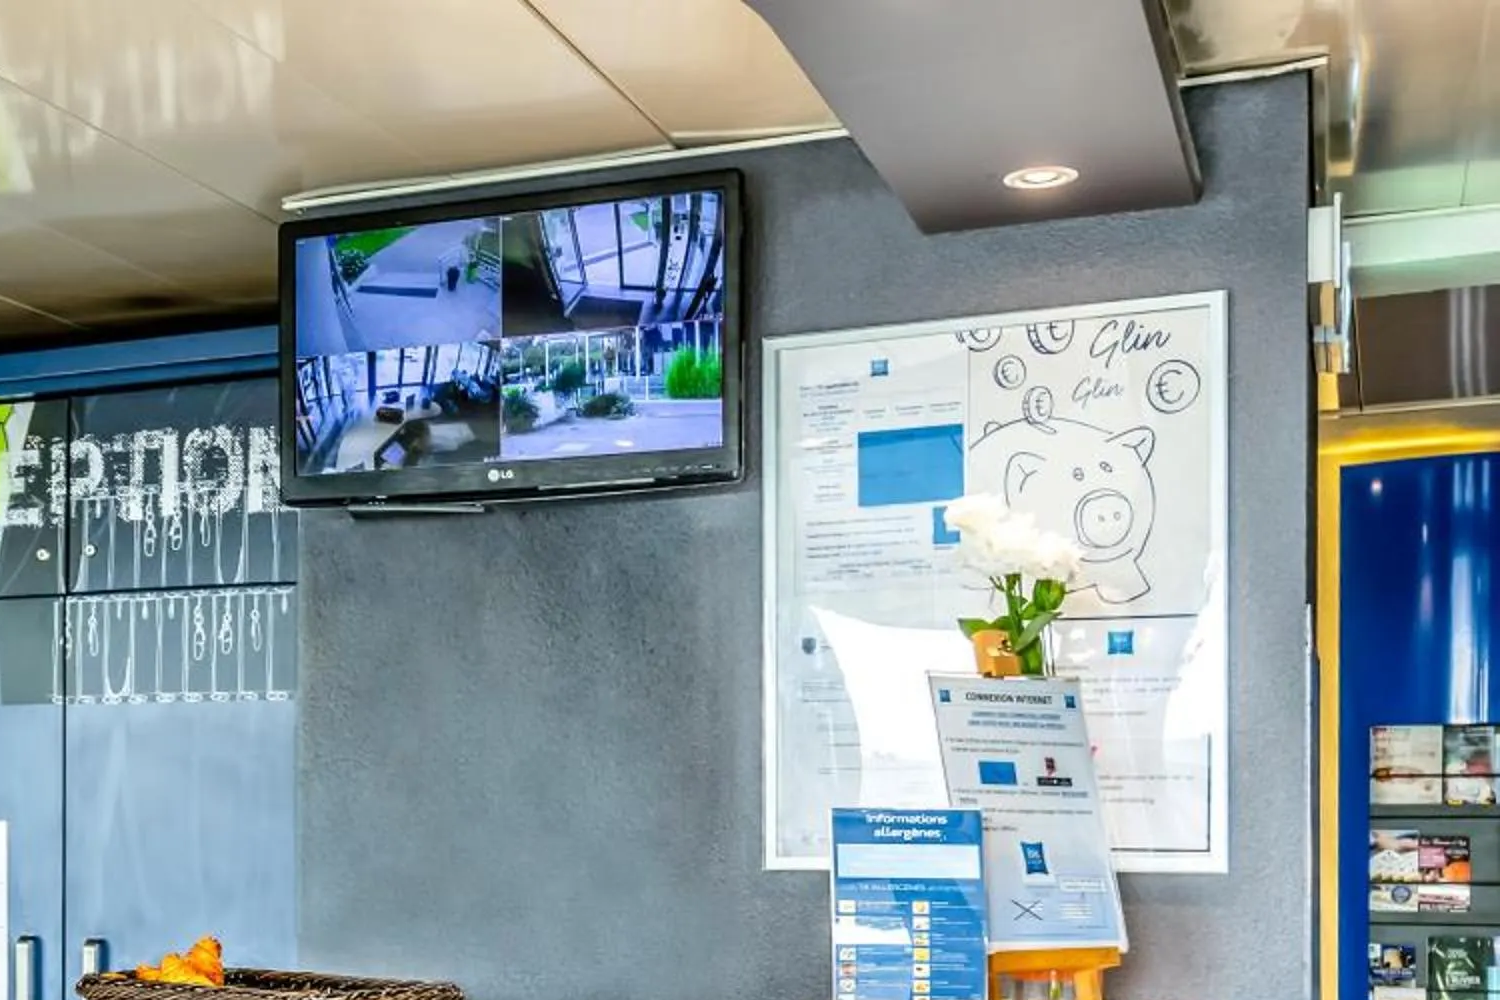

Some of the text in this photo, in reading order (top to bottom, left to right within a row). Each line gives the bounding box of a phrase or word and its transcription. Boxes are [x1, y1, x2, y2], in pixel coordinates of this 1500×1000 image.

[1089, 319, 1171, 368] Glin
[1071, 375, 1123, 409] Glin
[865, 813, 949, 825] Informations
